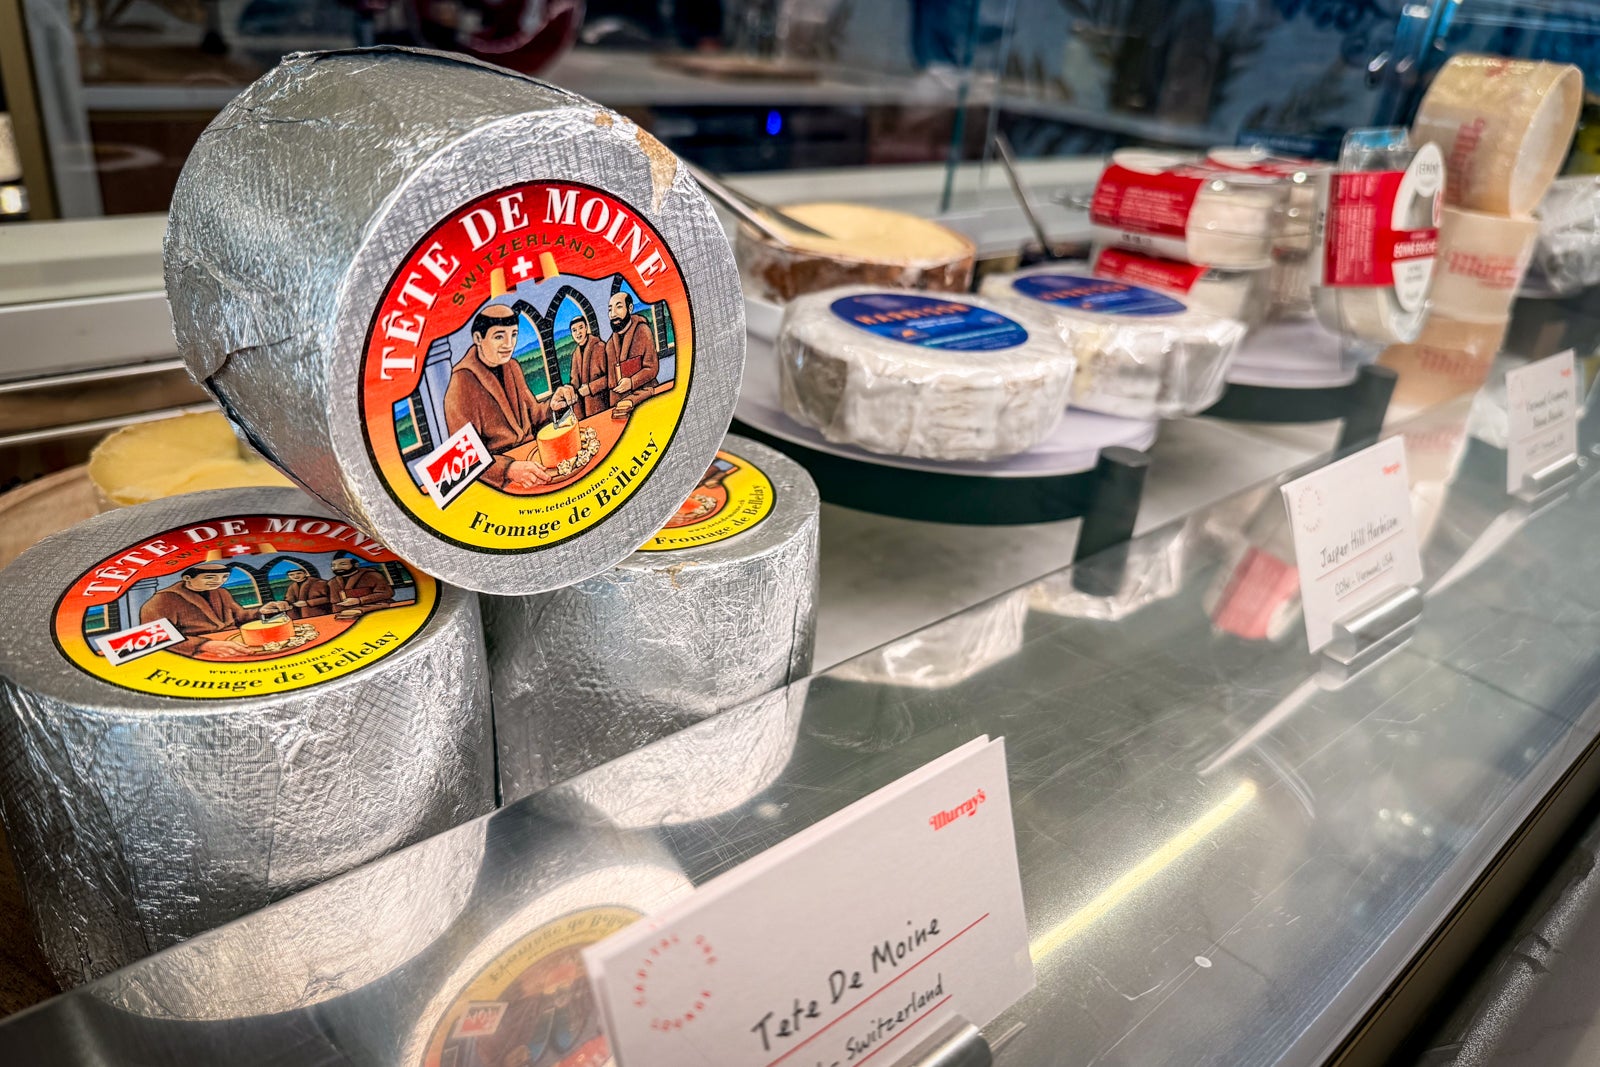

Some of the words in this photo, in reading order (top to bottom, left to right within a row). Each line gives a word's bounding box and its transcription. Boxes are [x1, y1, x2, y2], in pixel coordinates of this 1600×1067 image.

[380, 241, 461, 380] TÊTE
[458, 192, 530, 252] DE
[542, 187, 668, 288] MOINE
[452, 232, 596, 306] SWITZERLAND
[435, 449, 480, 492] AOP
[517, 465, 621, 517] www.tetedemoine.ch
[468, 510, 562, 539] Fromage
[567, 502, 592, 527] de
[654, 525, 733, 545] Fromage
[732, 514, 751, 527] de
[1350, 527, 1367, 551] Hill
[82, 538, 180, 599] TÊTE
[183, 518, 251, 545] DE
[263, 517, 388, 556] MOINE
[165, 534, 317, 567] SWITZERLAND
[115, 630, 172, 656] AOP
[143, 667, 264, 692] Fromage
[273, 669, 305, 685] de
[315, 630, 398, 676] Bellelay
[208, 645, 345, 675] www.tetedemoine.ch
[928, 788, 986, 832] Murray's
[751, 998, 822, 1052] Tete
[828, 969, 864, 1005] De
[871, 918, 941, 974] Moine
[845, 972, 945, 1061] Switzerland
